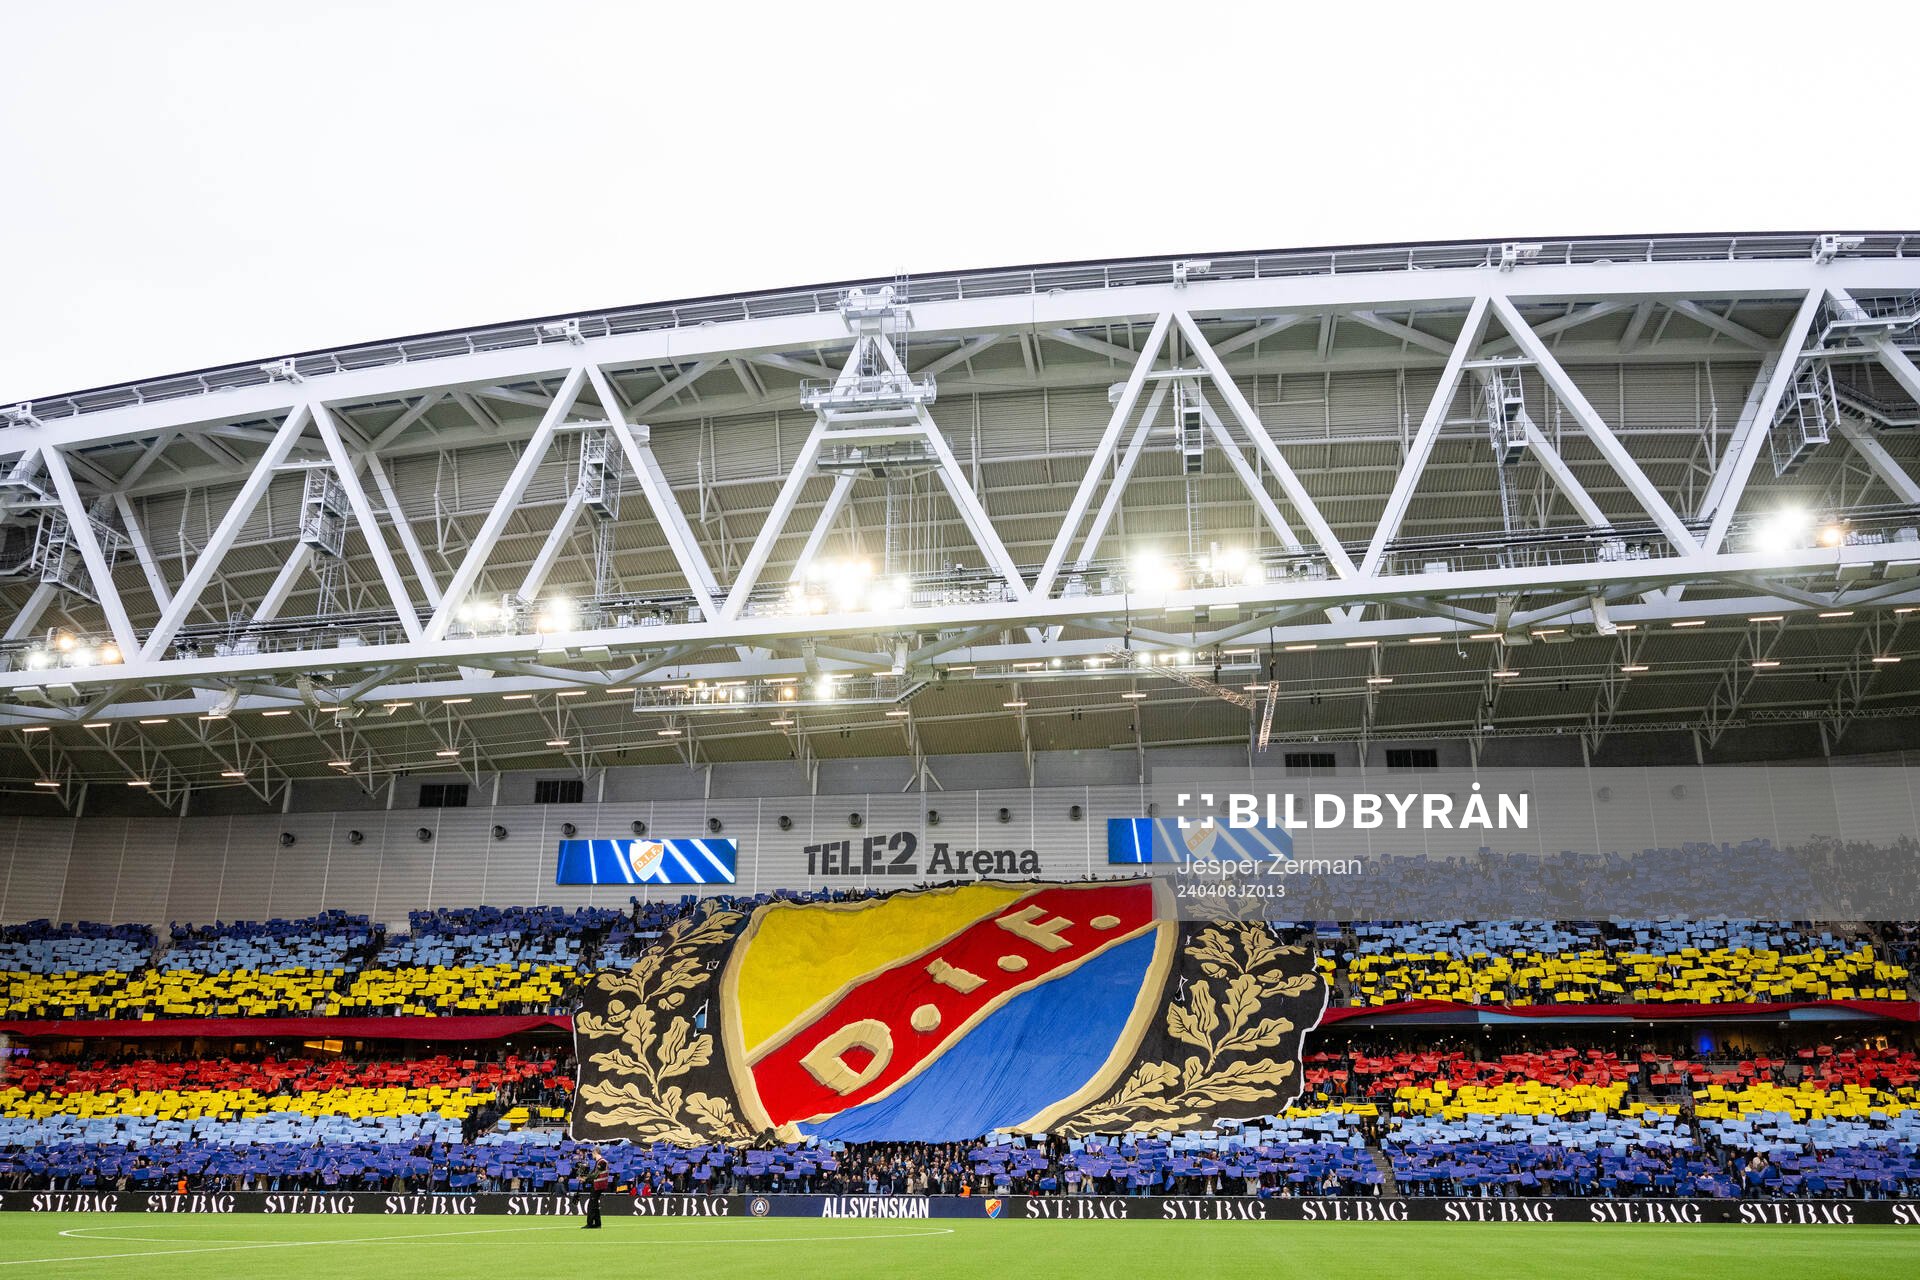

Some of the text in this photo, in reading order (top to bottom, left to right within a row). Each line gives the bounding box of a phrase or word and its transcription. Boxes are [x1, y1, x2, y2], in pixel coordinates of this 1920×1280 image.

[804, 831, 1041, 875] TELE2 Arena
[822, 1197, 929, 1218] ALLSVENSKAN
